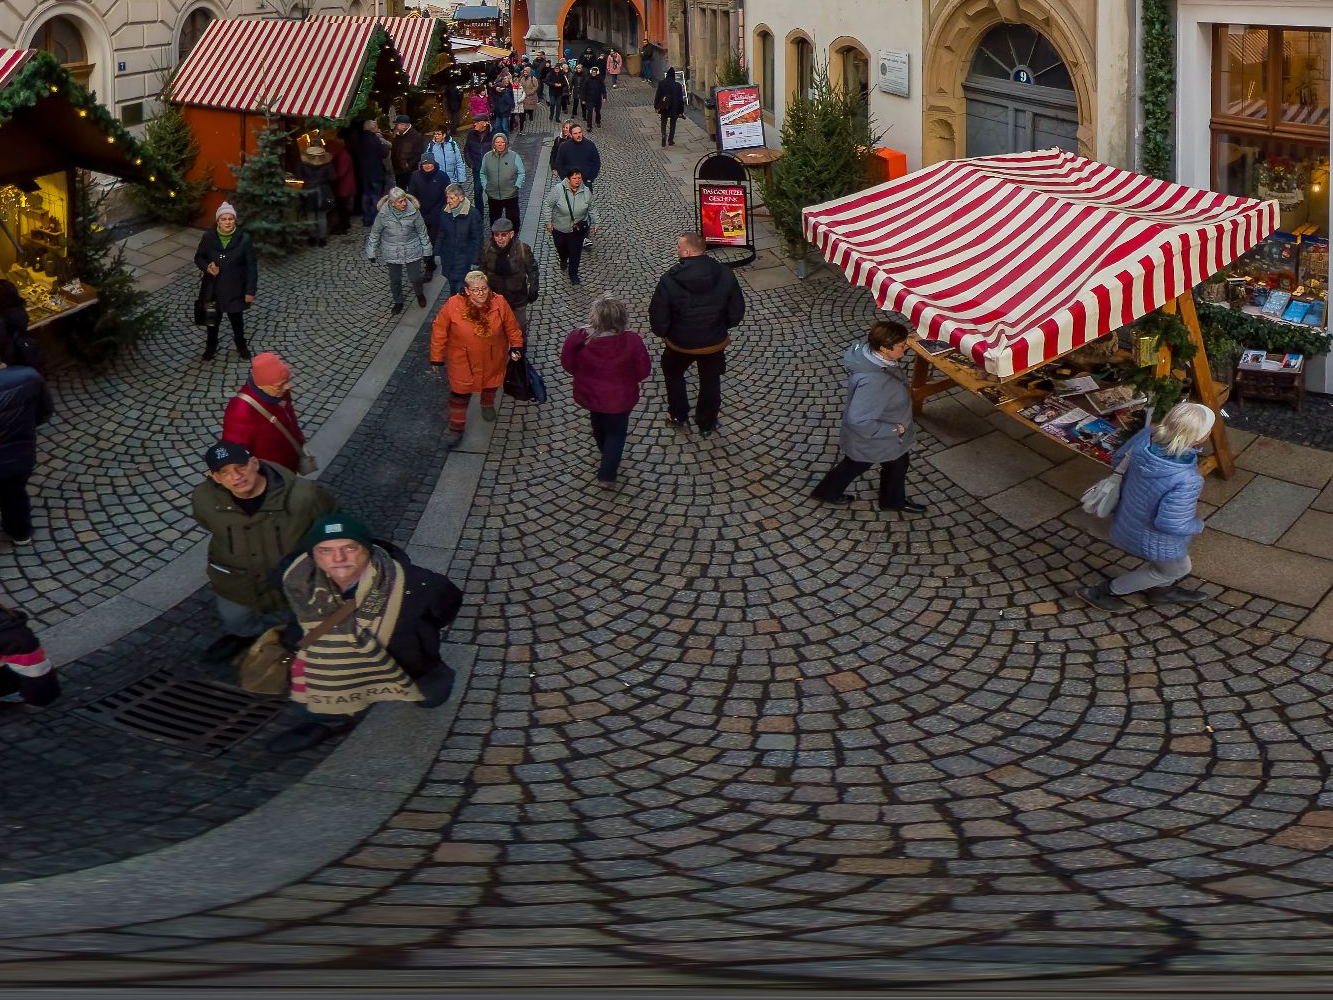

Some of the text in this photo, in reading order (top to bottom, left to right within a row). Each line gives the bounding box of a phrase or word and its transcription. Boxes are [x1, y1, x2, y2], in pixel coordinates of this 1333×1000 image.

[1020, 71, 1027, 82] 9
[708, 195, 738, 203] GESCHENK
[366, 687, 410, 697] RAW
